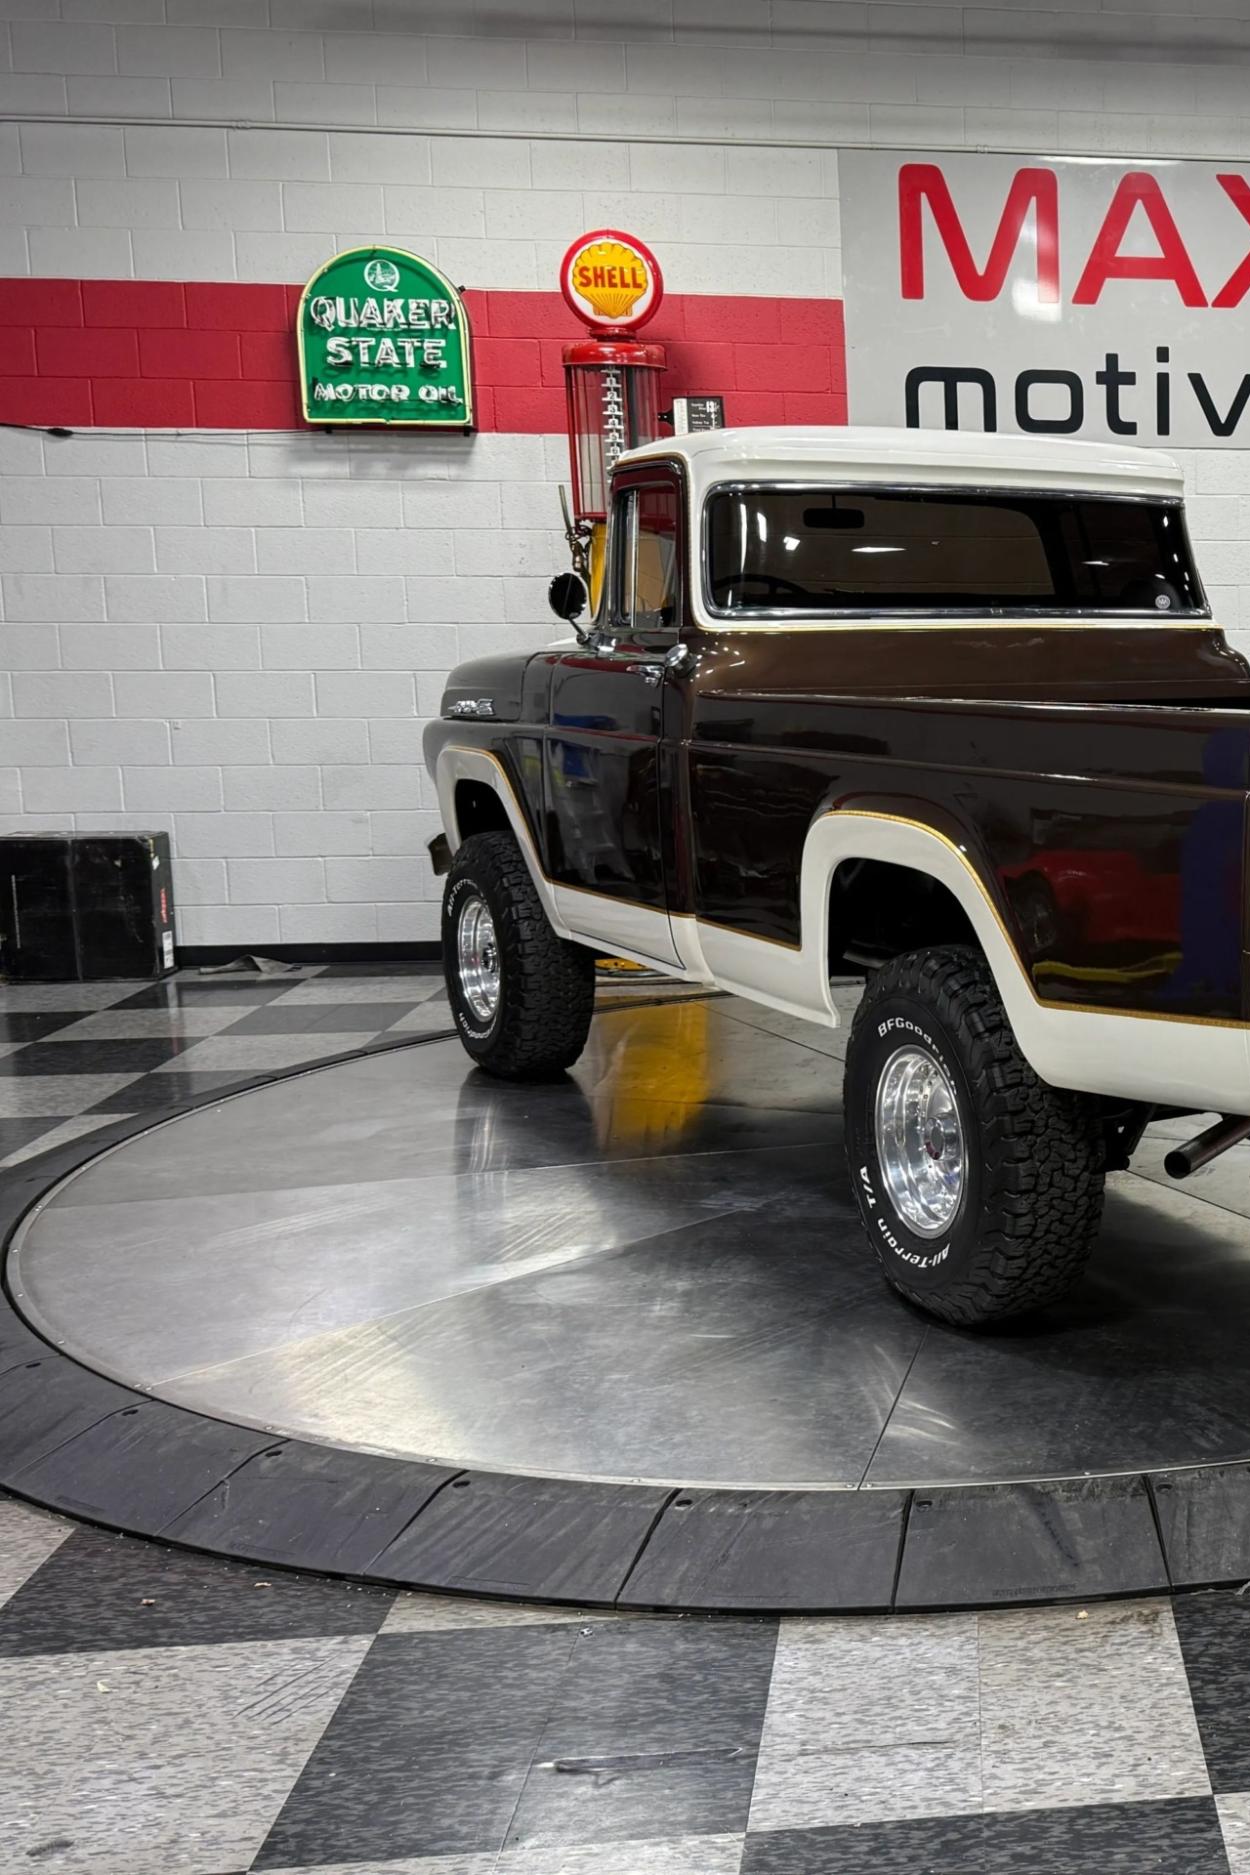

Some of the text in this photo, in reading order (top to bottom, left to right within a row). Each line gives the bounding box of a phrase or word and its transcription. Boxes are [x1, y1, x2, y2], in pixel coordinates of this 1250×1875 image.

[578, 265, 643, 289] SHELL
[310, 295, 457, 331] QUAKER
[326, 336, 448, 369] STATE
[313, 382, 463, 404] MOTOR OIL
[878, 1218, 951, 1268] All-Terrain
